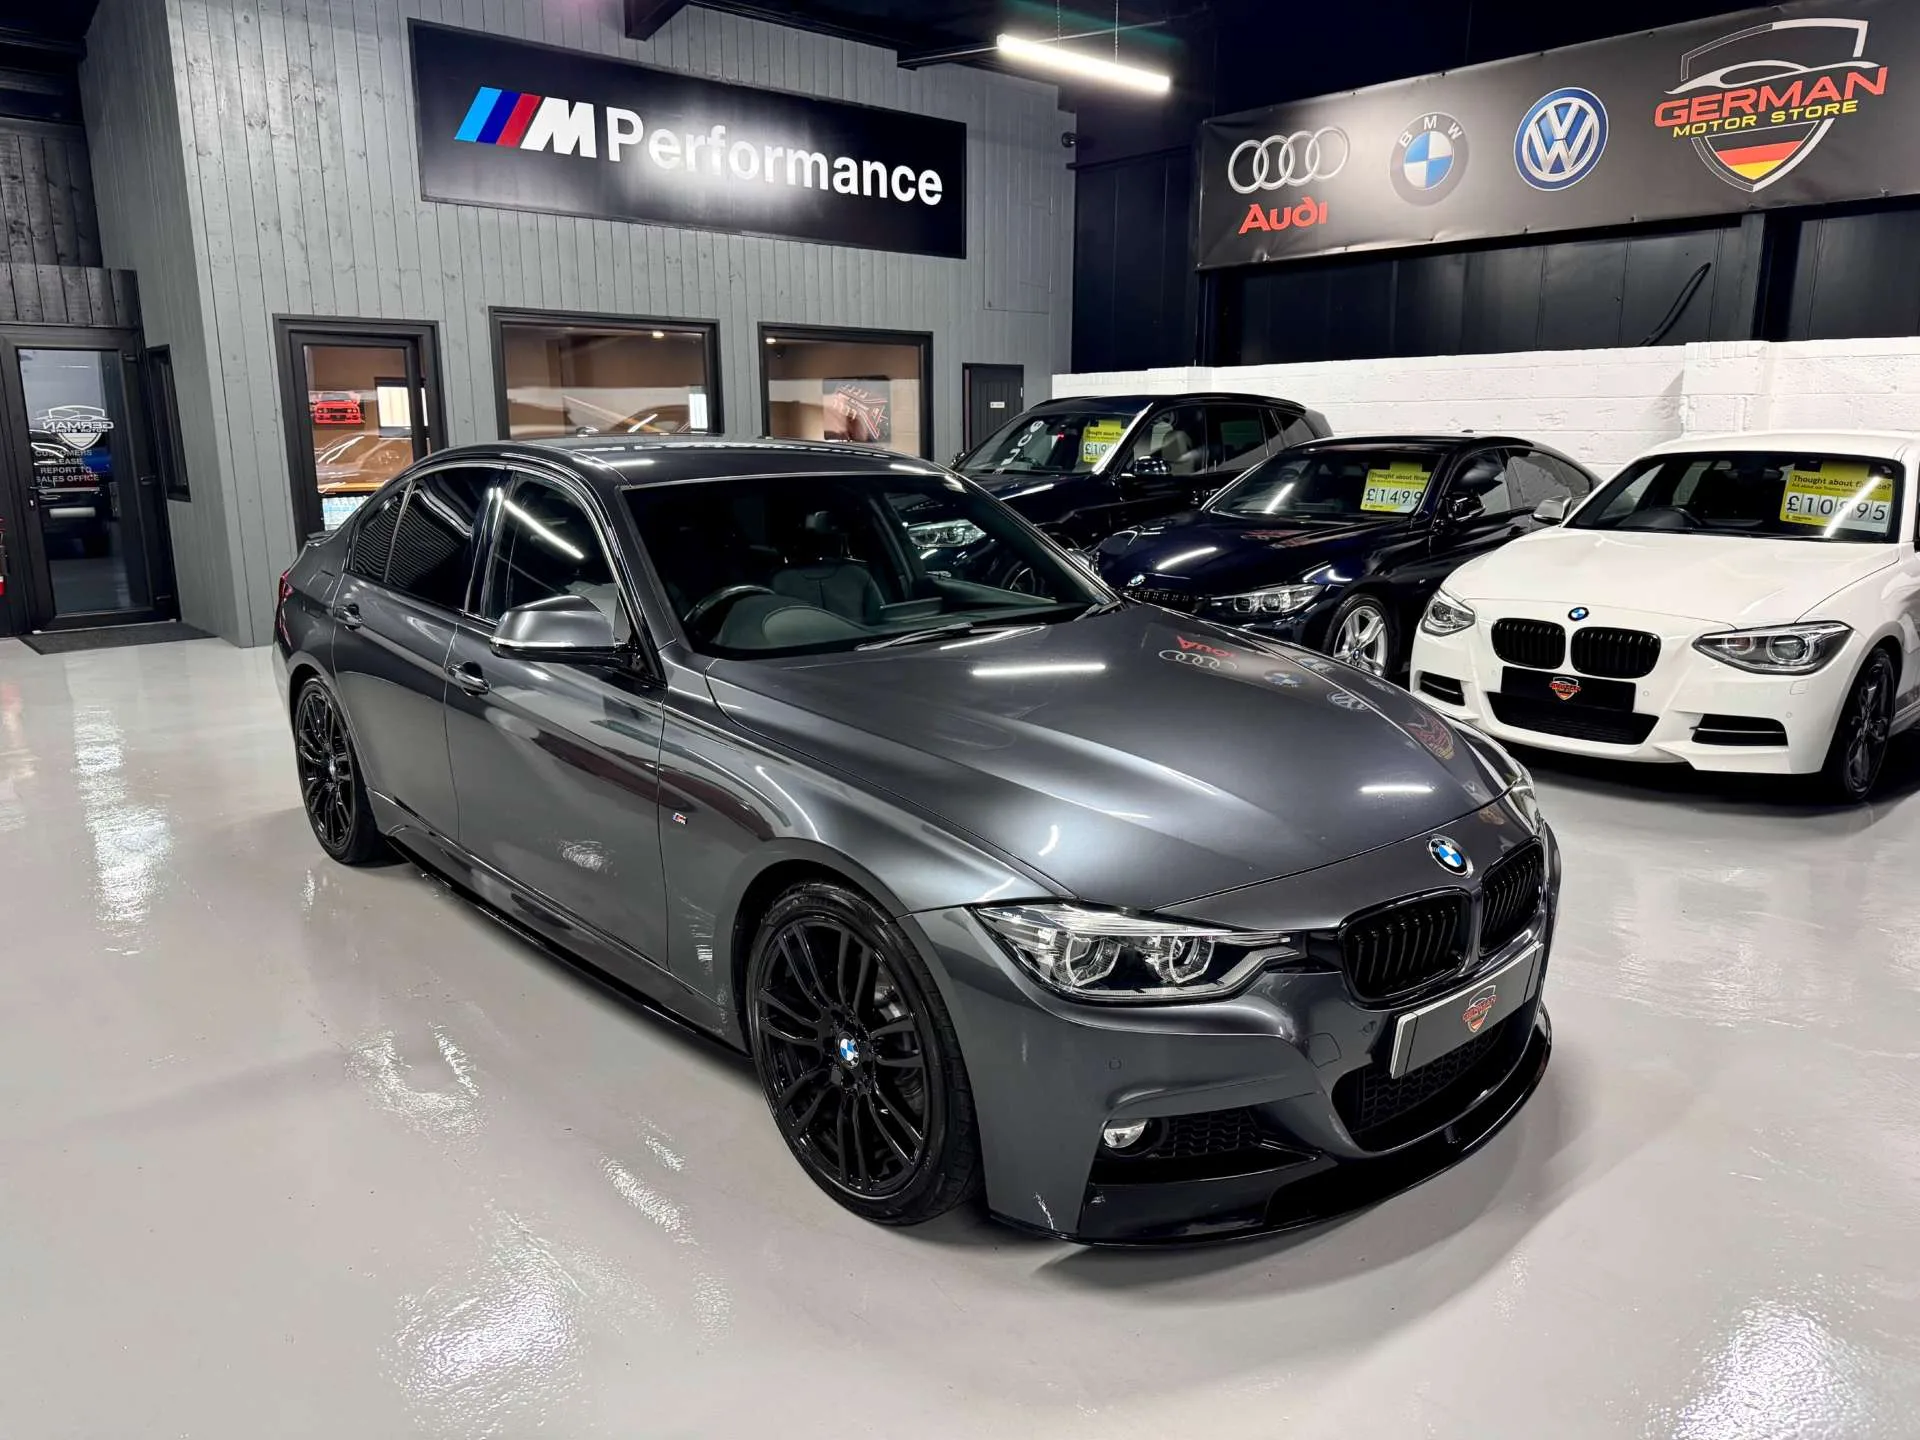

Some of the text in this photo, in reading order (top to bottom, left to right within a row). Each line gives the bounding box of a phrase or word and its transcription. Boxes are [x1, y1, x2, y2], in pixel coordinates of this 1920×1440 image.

[1654, 66, 1888, 128] GERMAN
[1399, 115, 1463, 148] BMW
[1672, 100, 1859, 138] MOTOR STORE
[520, 96, 944, 206] M Performance
[1238, 195, 1328, 235] Audi
[1793, 475, 1826, 485] Thought
[1829, 478, 1853, 487] about
